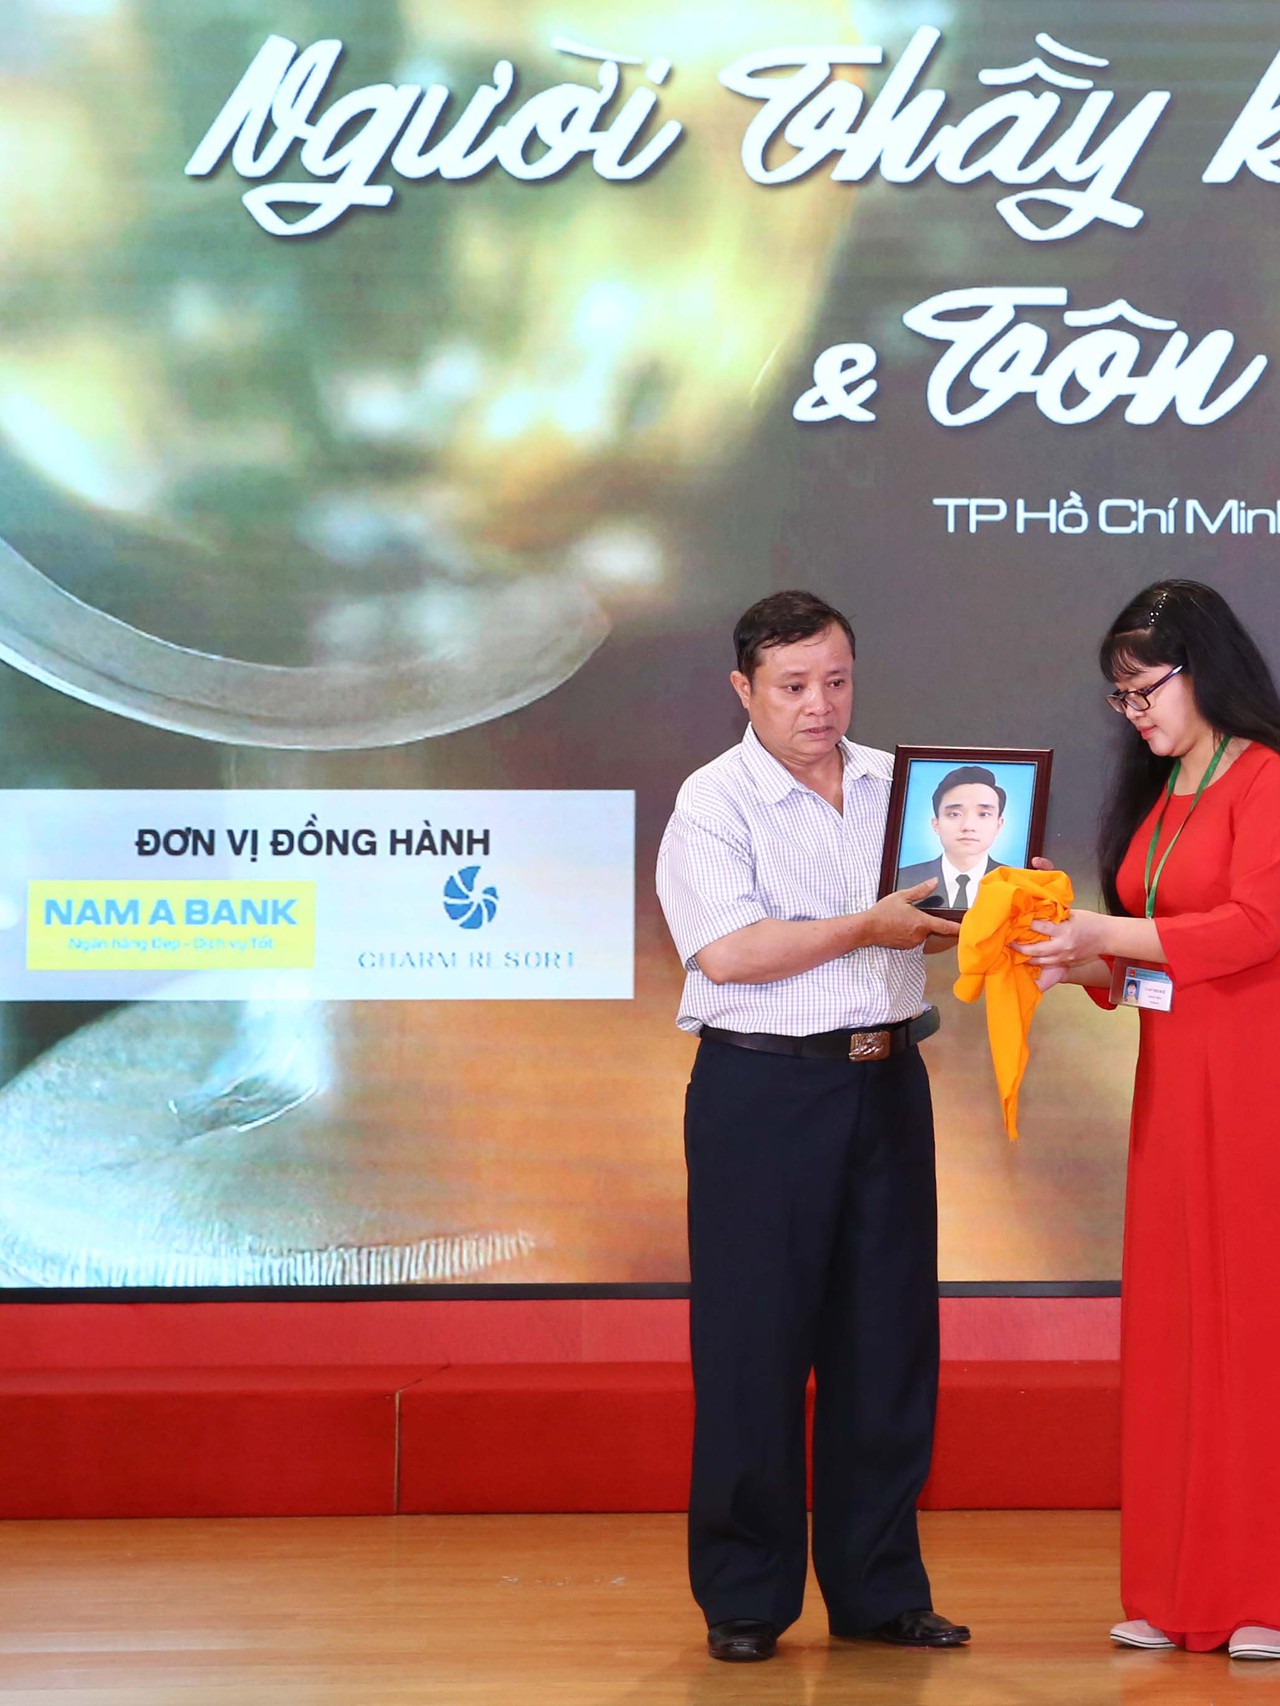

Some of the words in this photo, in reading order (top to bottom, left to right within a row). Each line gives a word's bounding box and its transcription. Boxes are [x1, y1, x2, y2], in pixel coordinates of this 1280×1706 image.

[184, 33, 683, 237] Người
[717, 24, 1172, 242] Thầy
[792, 342, 878, 423] &
[902, 286, 1269, 427] Tôn
[932, 498, 1009, 536] TP
[1016, 491, 1090, 536] Hồ
[1098, 497, 1180, 536] Chí
[134, 825, 216, 857] ĐƠN
[226, 828, 259, 863] VỊ
[269, 813, 378, 857] ĐỒNG
[389, 819, 491, 857] HÀNH
[43, 897, 141, 927] NAM
[147, 897, 177, 927] A
[183, 897, 298, 927] BANK
